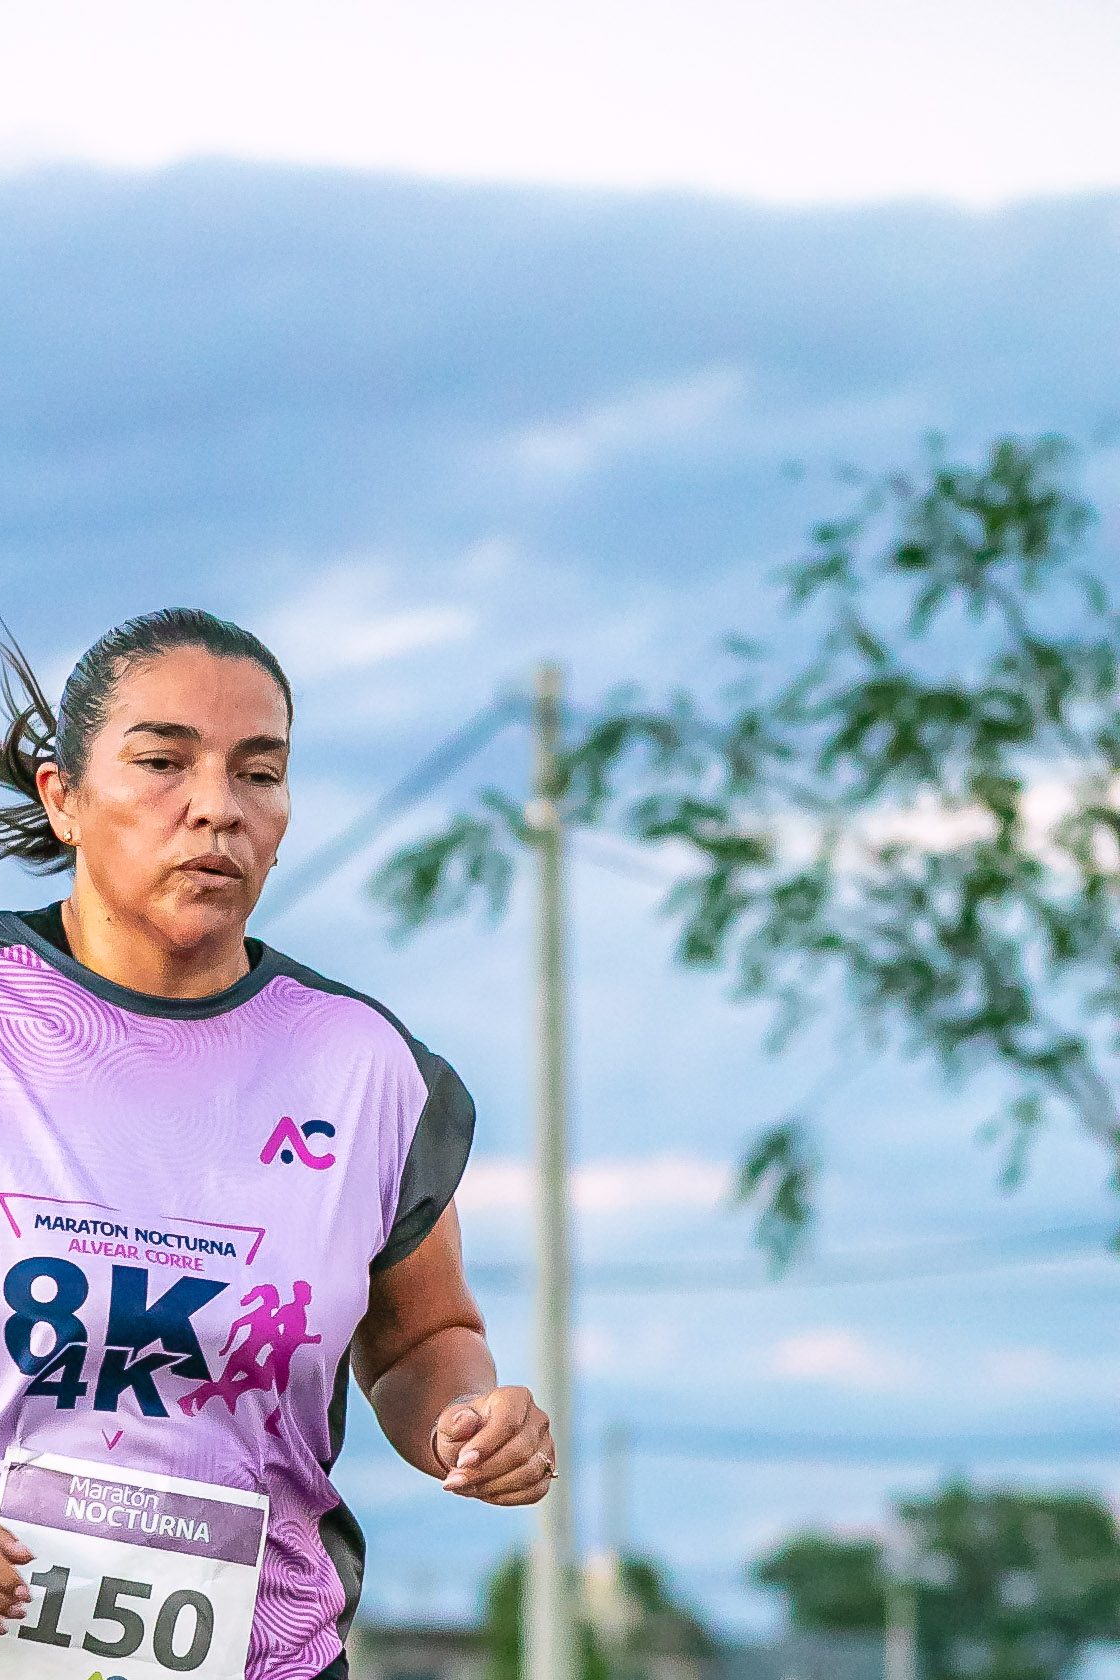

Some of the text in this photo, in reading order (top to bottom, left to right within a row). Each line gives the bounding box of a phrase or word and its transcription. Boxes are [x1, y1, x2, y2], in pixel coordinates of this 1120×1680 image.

[34, 1213, 237, 1258] MARATON NOCTURNA
[67, 1238, 205, 1272] ALVEAR CORRE
[3, 1256, 231, 1384] 8K
[22, 1344, 171, 1419] 4K
[68, 1475, 160, 1511] Maratón
[64, 1496, 211, 1544] NOCTURNA
[17, 1563, 215, 1673] 150
